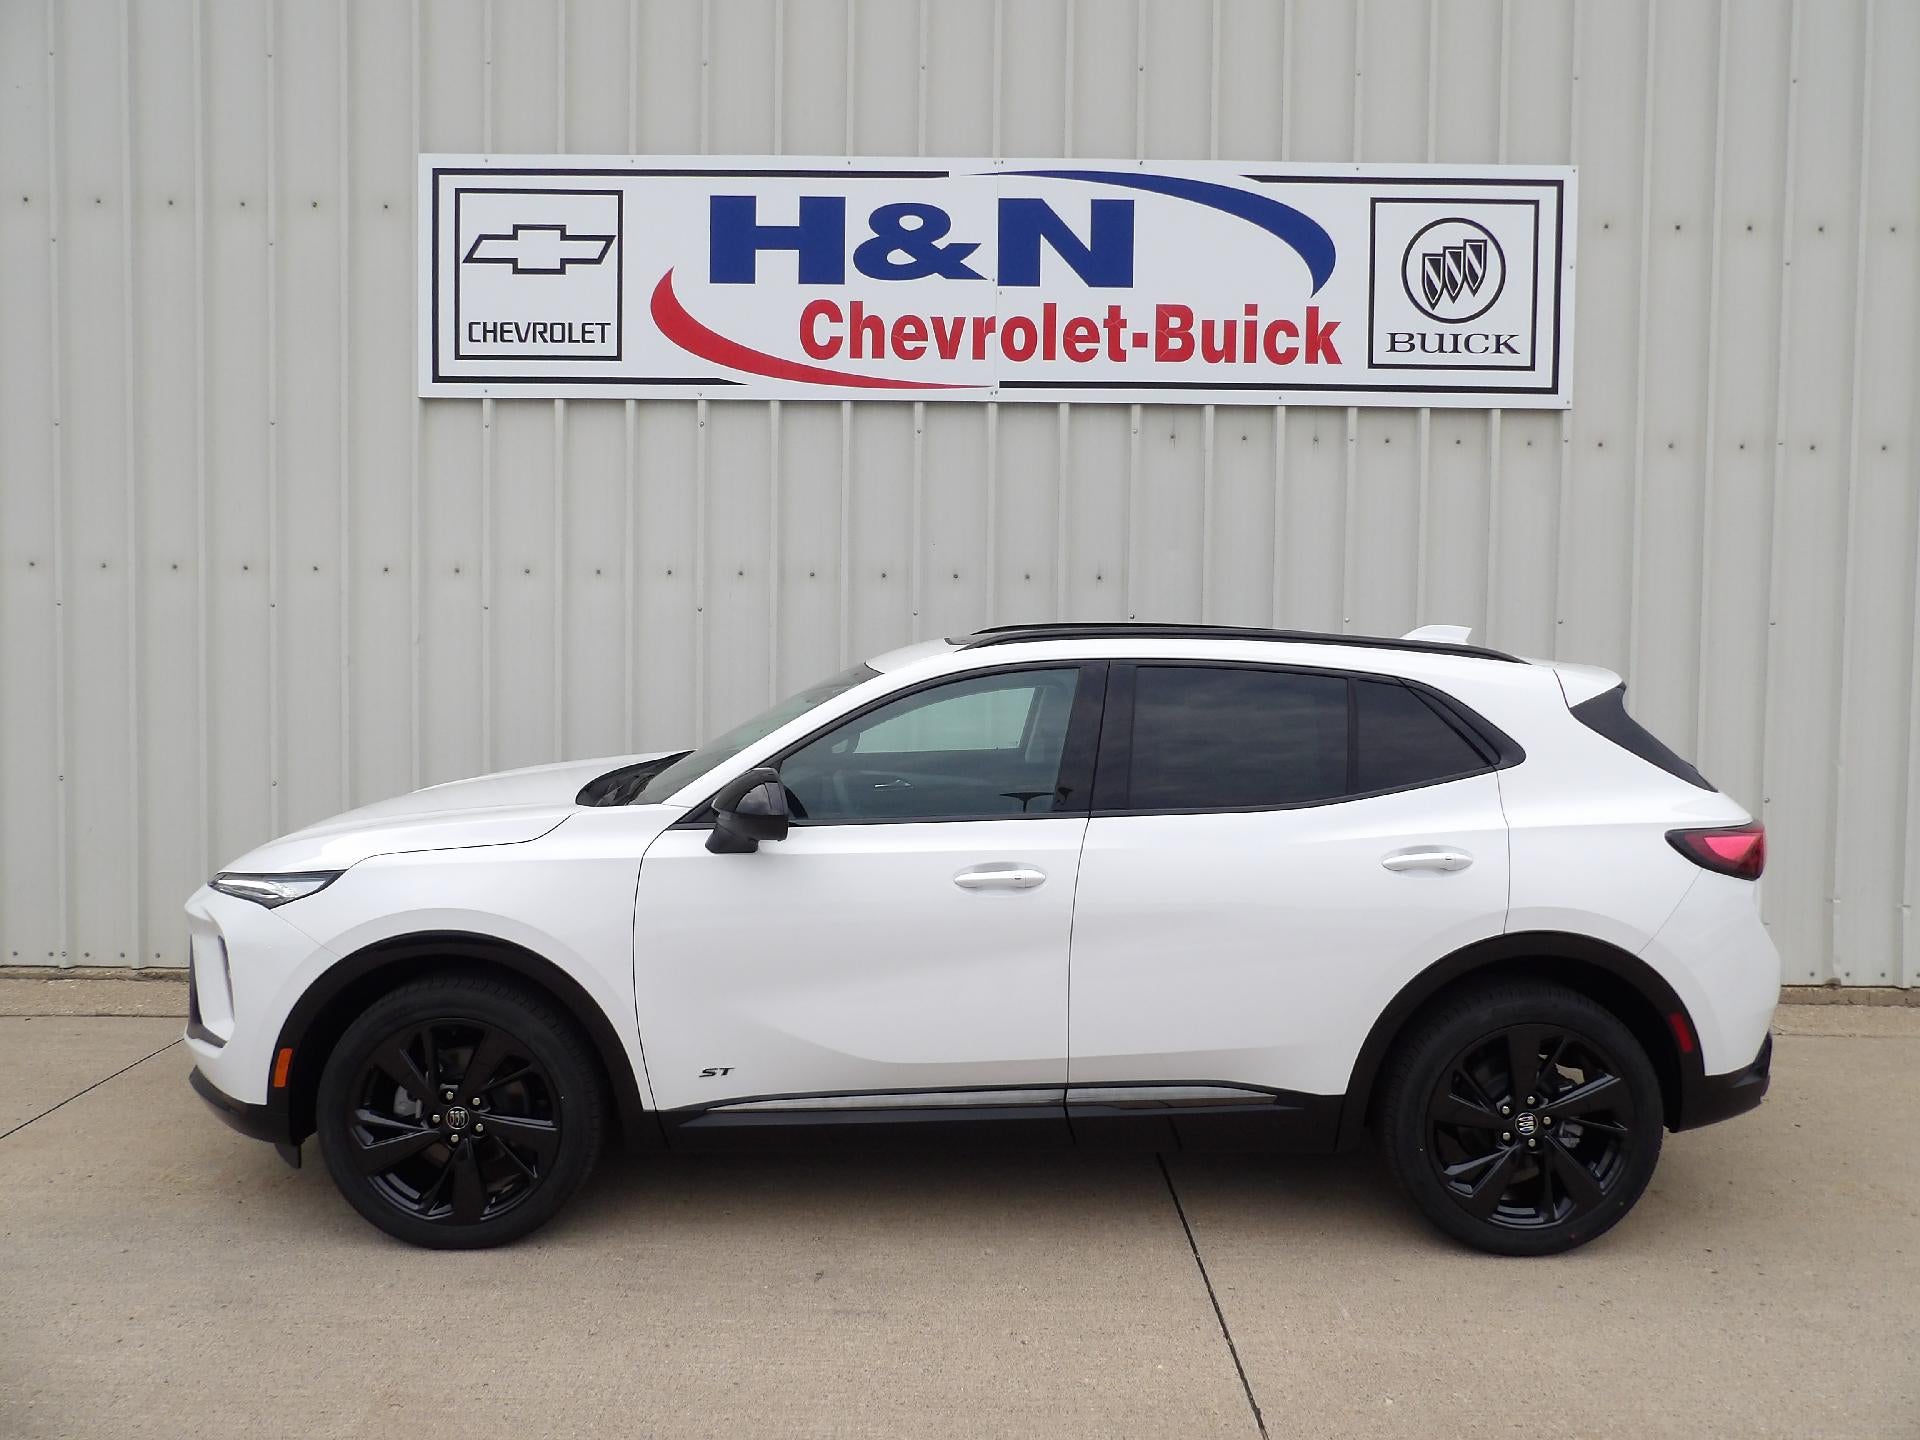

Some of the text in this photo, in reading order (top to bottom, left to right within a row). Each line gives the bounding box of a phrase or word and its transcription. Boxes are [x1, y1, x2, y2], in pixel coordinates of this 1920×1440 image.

[709, 194, 1135, 288] H&N
[468, 321, 611, 344] CHEVROLET
[799, 298, 1342, 366] Chevrolet-Buick
[1385, 331, 1520, 354] BUICK
[698, 1067, 735, 1078] ST
